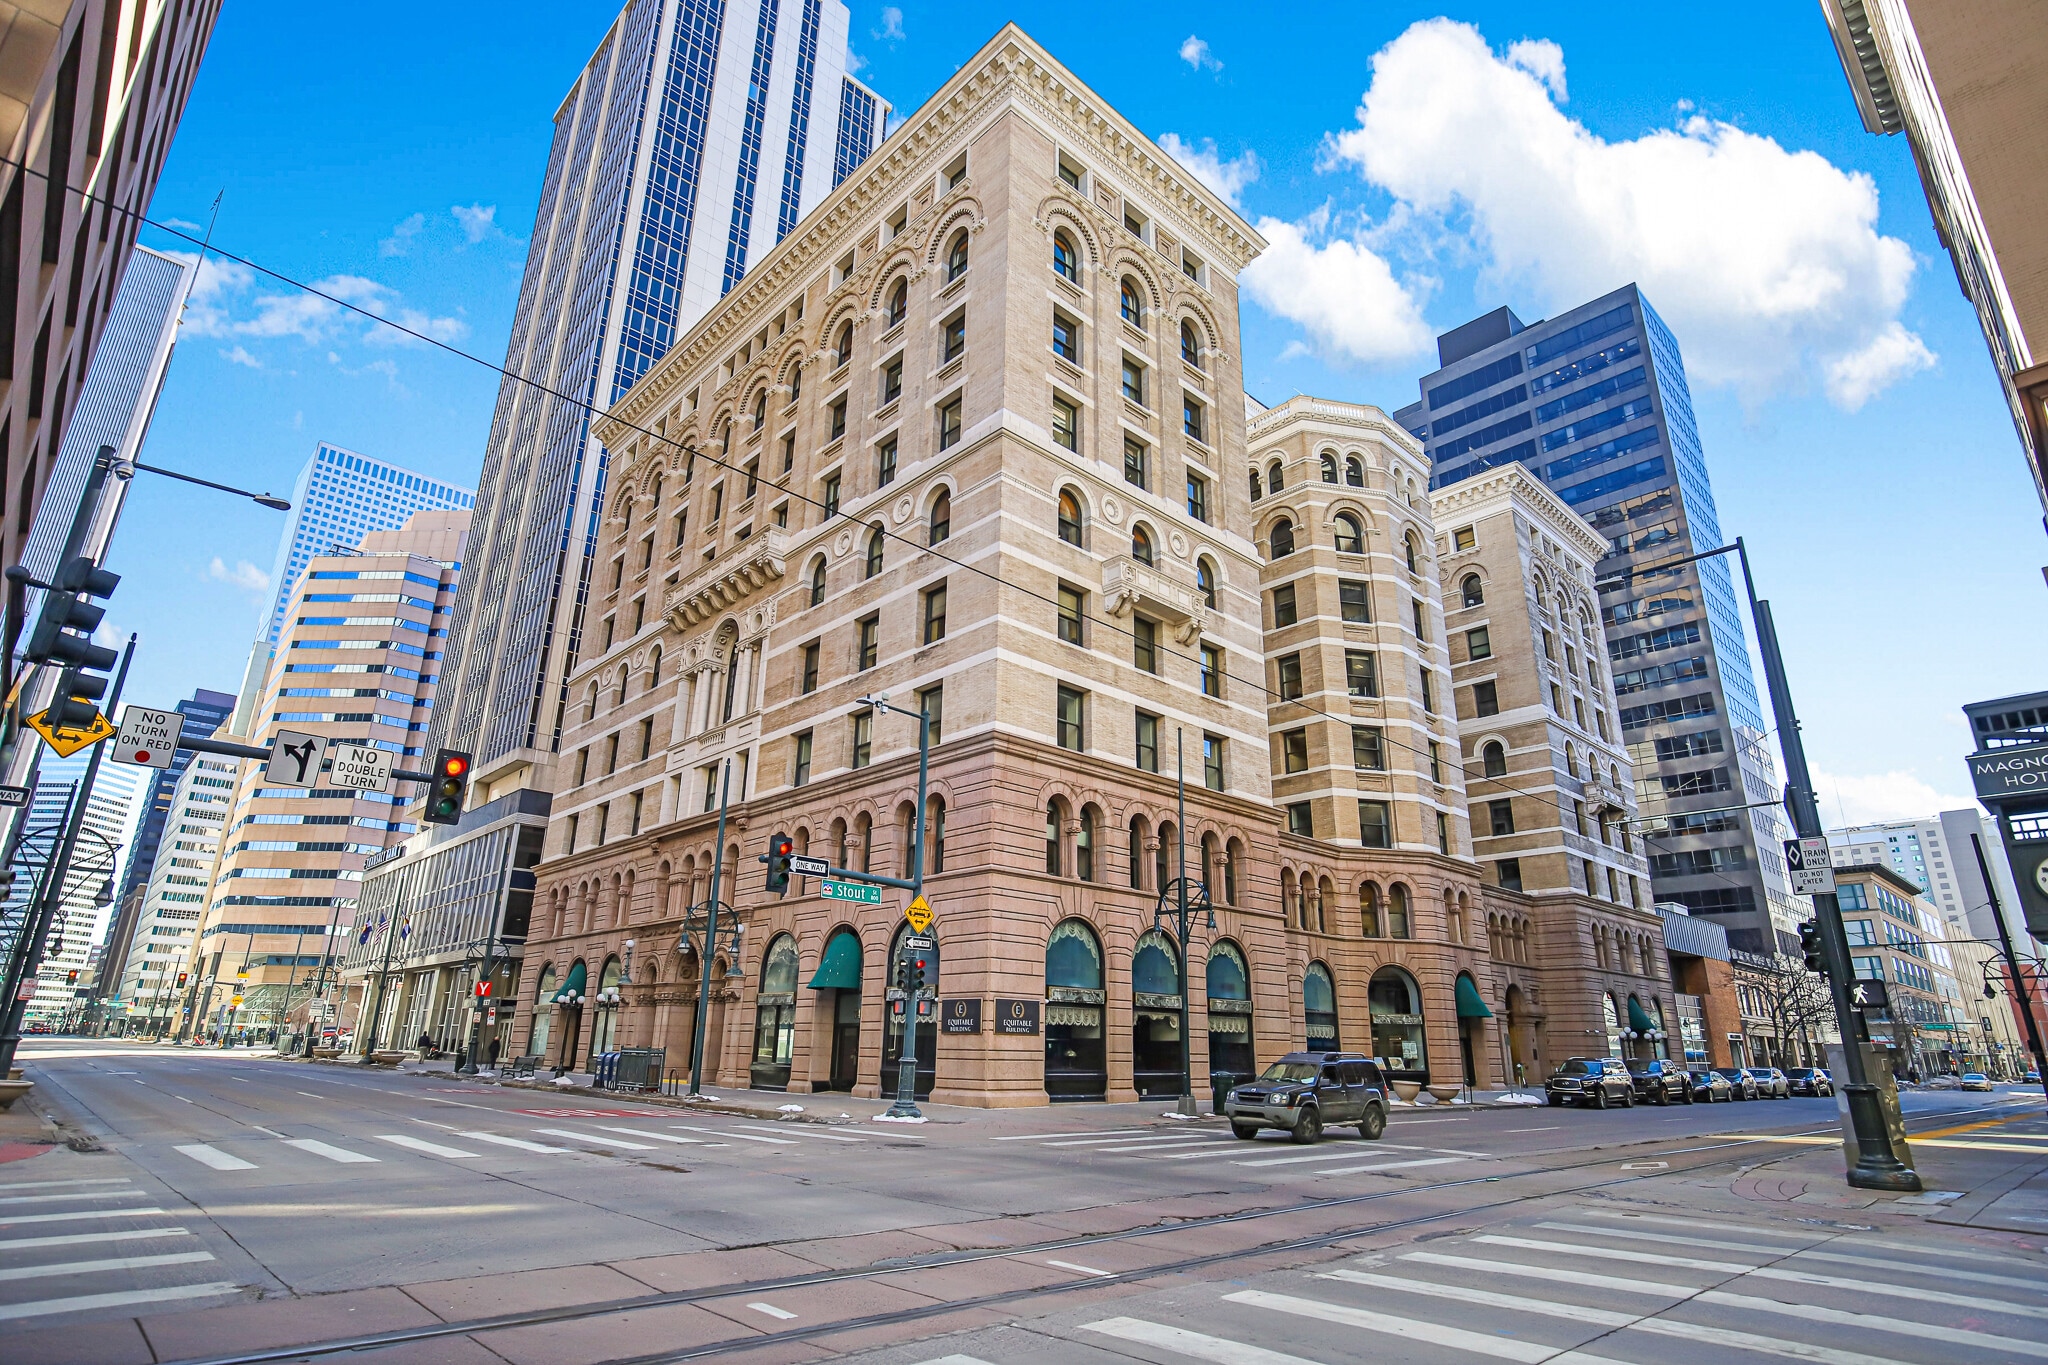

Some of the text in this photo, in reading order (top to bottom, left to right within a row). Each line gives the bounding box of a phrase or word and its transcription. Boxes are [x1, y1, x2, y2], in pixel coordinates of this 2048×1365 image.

[142, 712, 166, 725] NO
[134, 724, 169, 738] TURN
[121, 735, 172, 751] ON RED
[352, 749, 378, 764] NO
[338, 762, 386, 778] DOUBLE
[344, 775, 377, 788] TURN
[1803, 849, 1827, 858] TRAIN
[796, 860, 824, 872] ONE WAY
[1806, 858, 1826, 867] ONLY
[1811, 870, 1824, 878] NOT
[837, 884, 865, 900] Stout
[479, 982, 490, 995] Y
[958, 1004, 963, 1014] E
[1015, 1005, 1021, 1015] E
[947, 1018, 974, 1027] EQUITABLE
[1003, 1019, 1033, 1027] EQUITABLE
